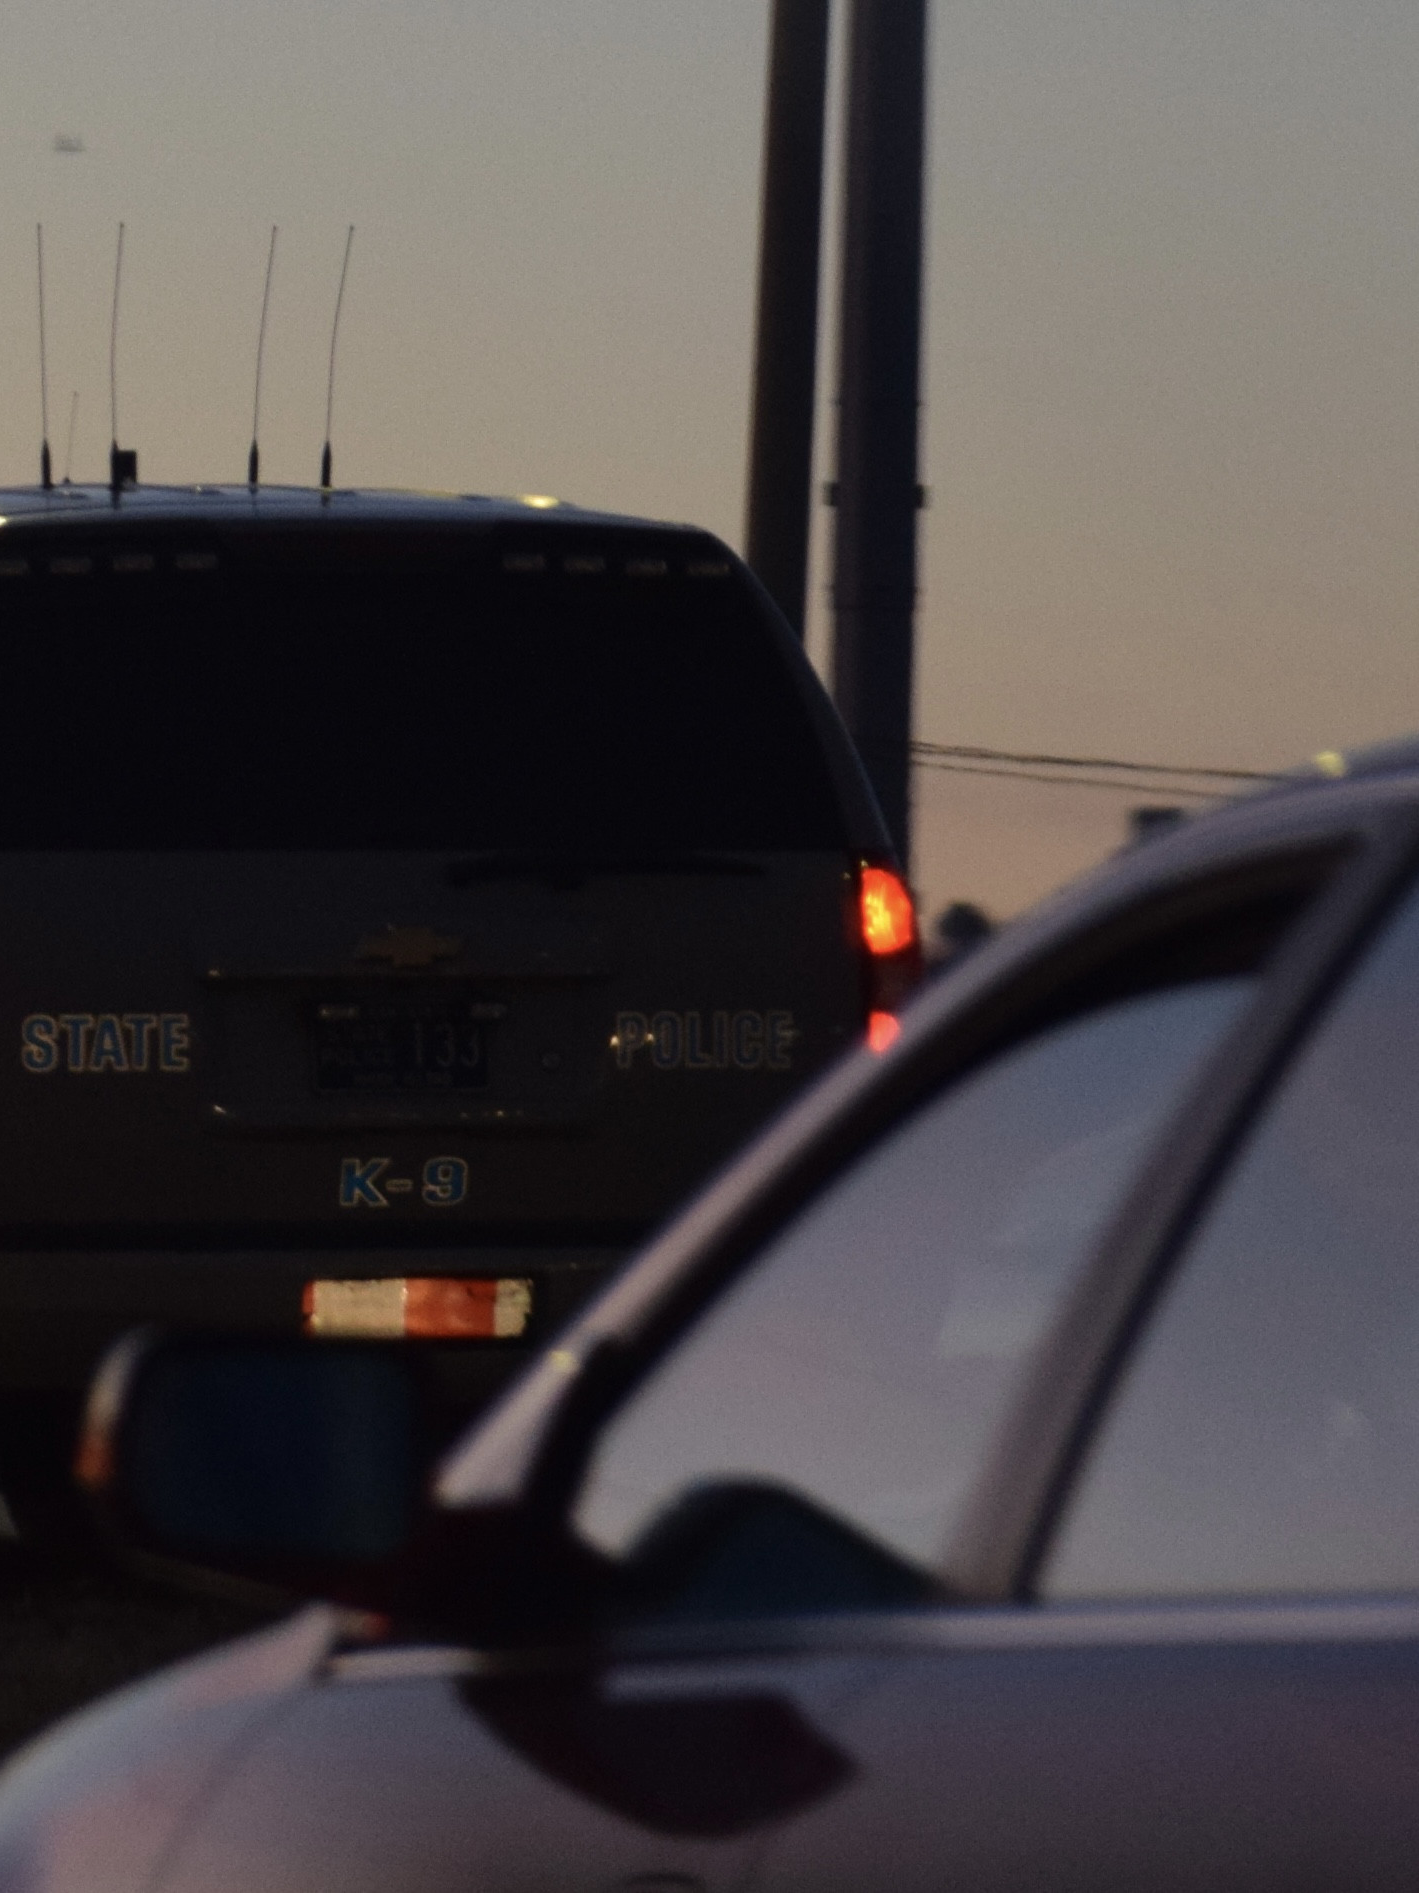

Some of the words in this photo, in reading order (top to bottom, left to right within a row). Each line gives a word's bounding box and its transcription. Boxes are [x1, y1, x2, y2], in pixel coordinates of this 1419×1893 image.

[20, 1012, 191, 1073] STATE
[613, 1009, 795, 1070] POLICE
[339, 1156, 469, 1207] K-9
